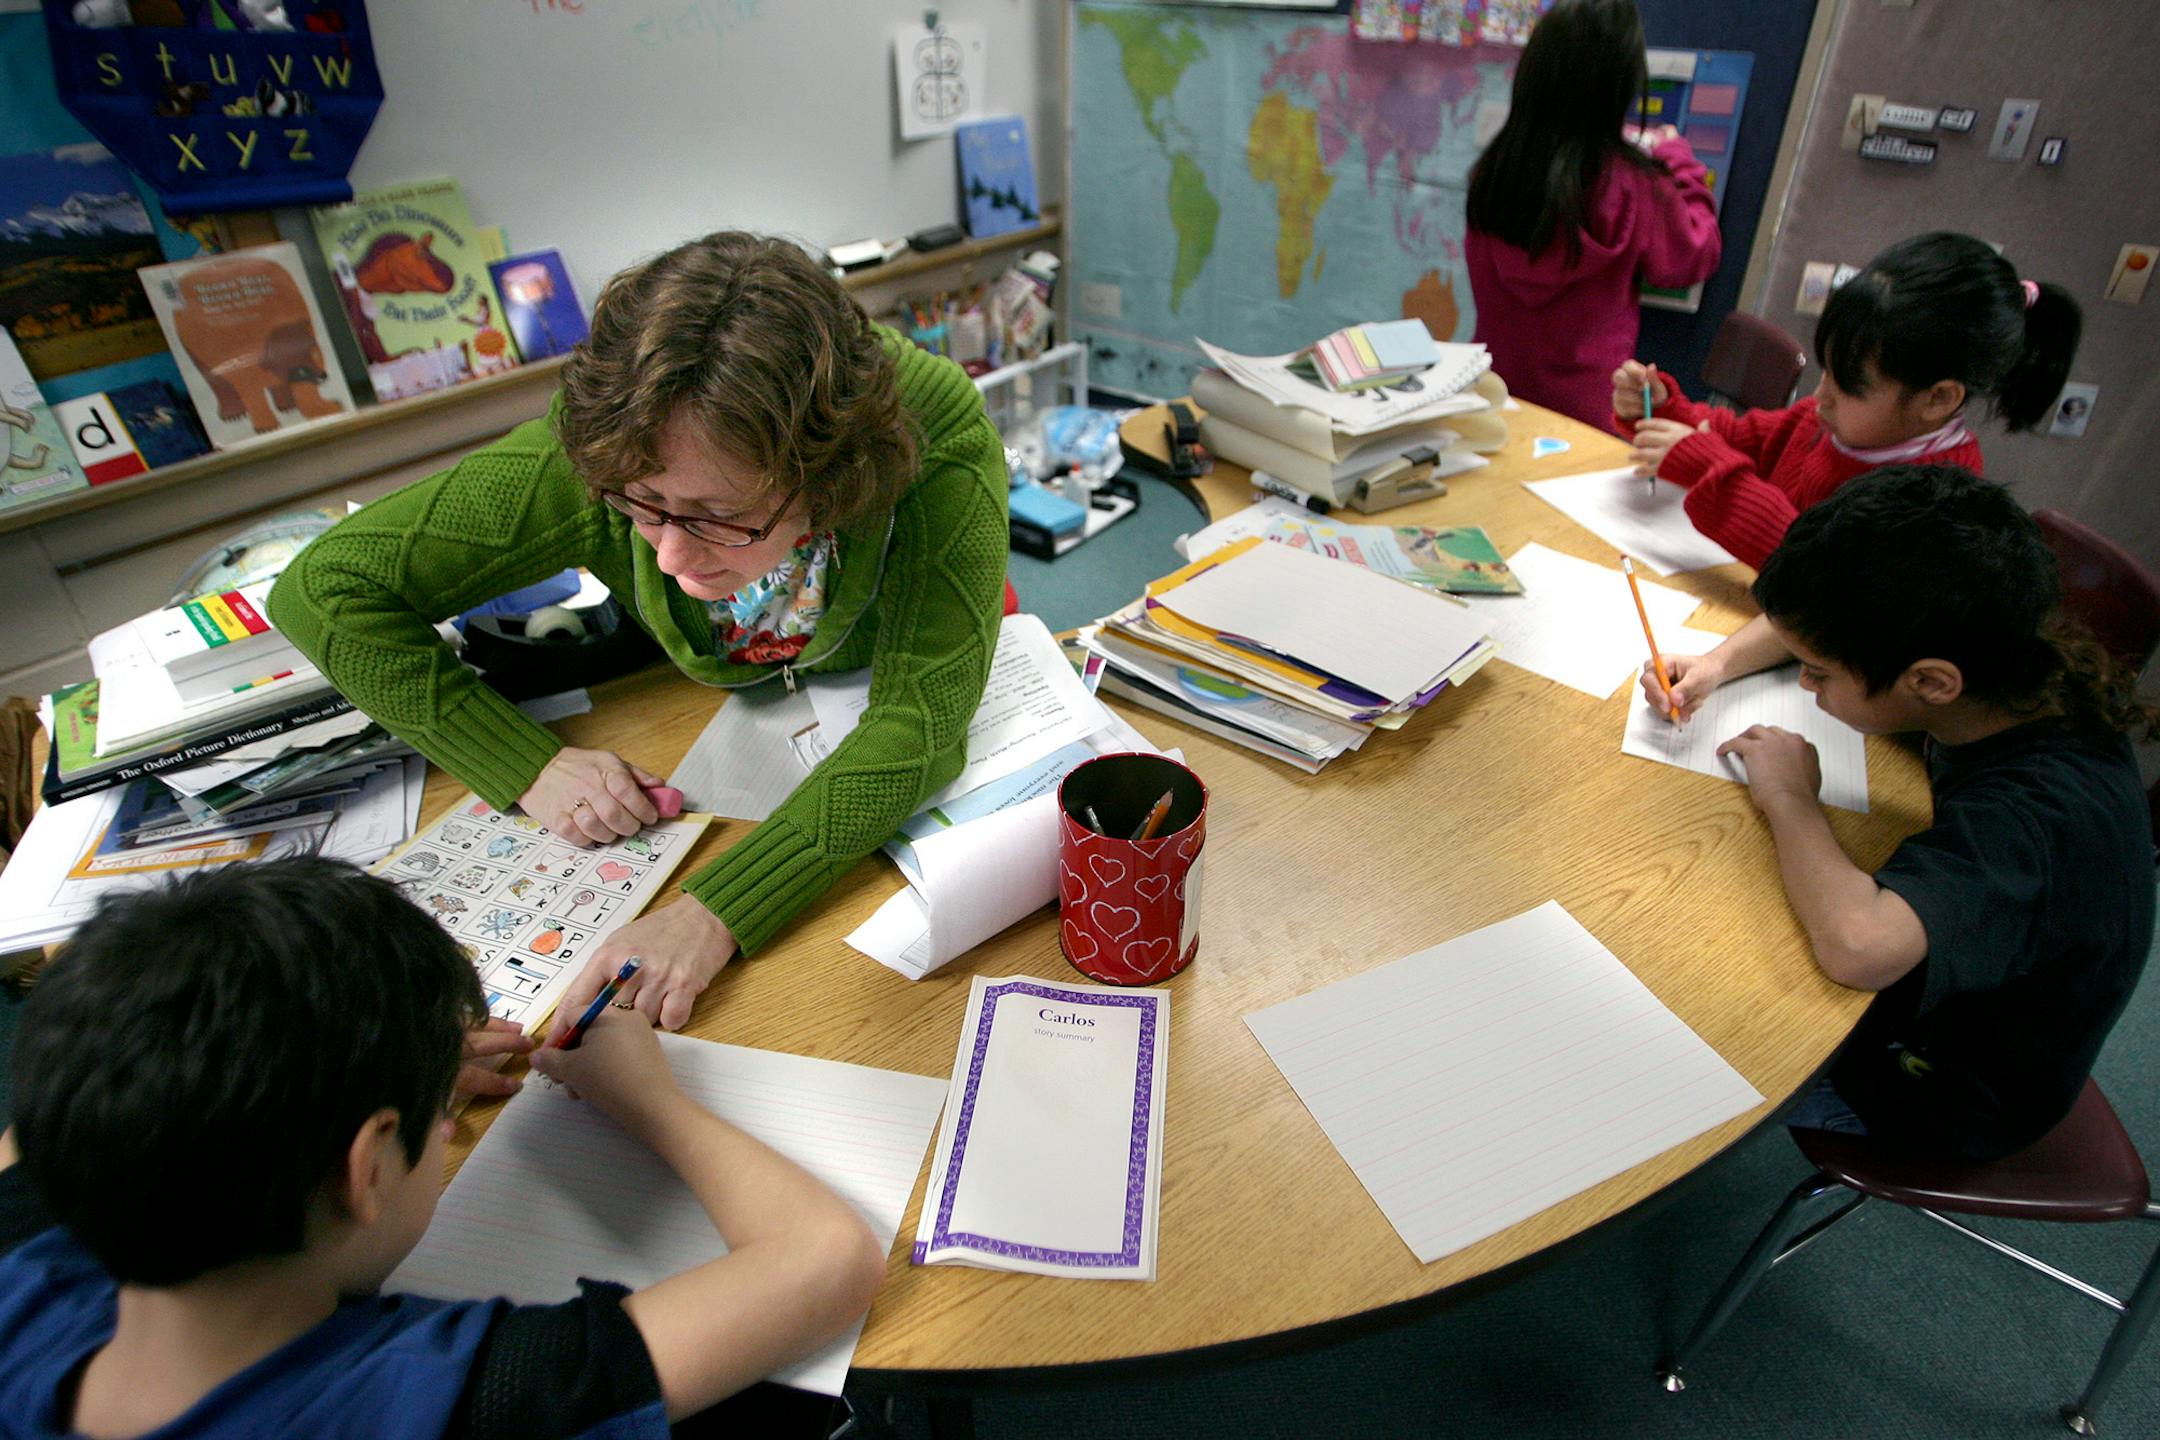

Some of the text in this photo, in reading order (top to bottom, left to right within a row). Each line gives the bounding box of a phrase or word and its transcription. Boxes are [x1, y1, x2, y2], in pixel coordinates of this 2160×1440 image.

[96, 41, 352, 88] s t u v w
[169, 128, 315, 173] x y z
[367, 209, 391, 226] Do
[395, 204, 464, 247] Dinosaurs
[383, 300, 406, 321] Eat
[412, 306, 448, 321] Their
[76, 406, 116, 449] d
[117, 766, 142, 780] The
[143, 752, 183, 772] Oxford
[184, 740, 226, 760] Picture
[228, 721, 284, 747] Dictionary
[291, 710, 321, 726] Shapiro
[321, 705, 335, 718] and
[474, 829, 488, 839] E
[654, 836, 667, 846] D
[489, 870, 508, 881] J
[562, 867, 576, 877] g
[631, 870, 642, 879] H
[550, 884, 563, 895] K
[621, 880, 633, 891] h
[536, 898, 547, 908] k
[600, 898, 611, 911] L
[447, 916, 459, 925] n
[516, 914, 533, 926] O
[503, 932, 514, 940] o
[568, 932, 584, 945] P
[480, 950, 497, 963] S
[558, 949, 573, 959] p
[514, 975, 531, 991] T
[503, 1008, 516, 1021] X
[1039, 1008, 1096, 1027] Carlos
[1034, 1028, 1096, 1043] story summary
